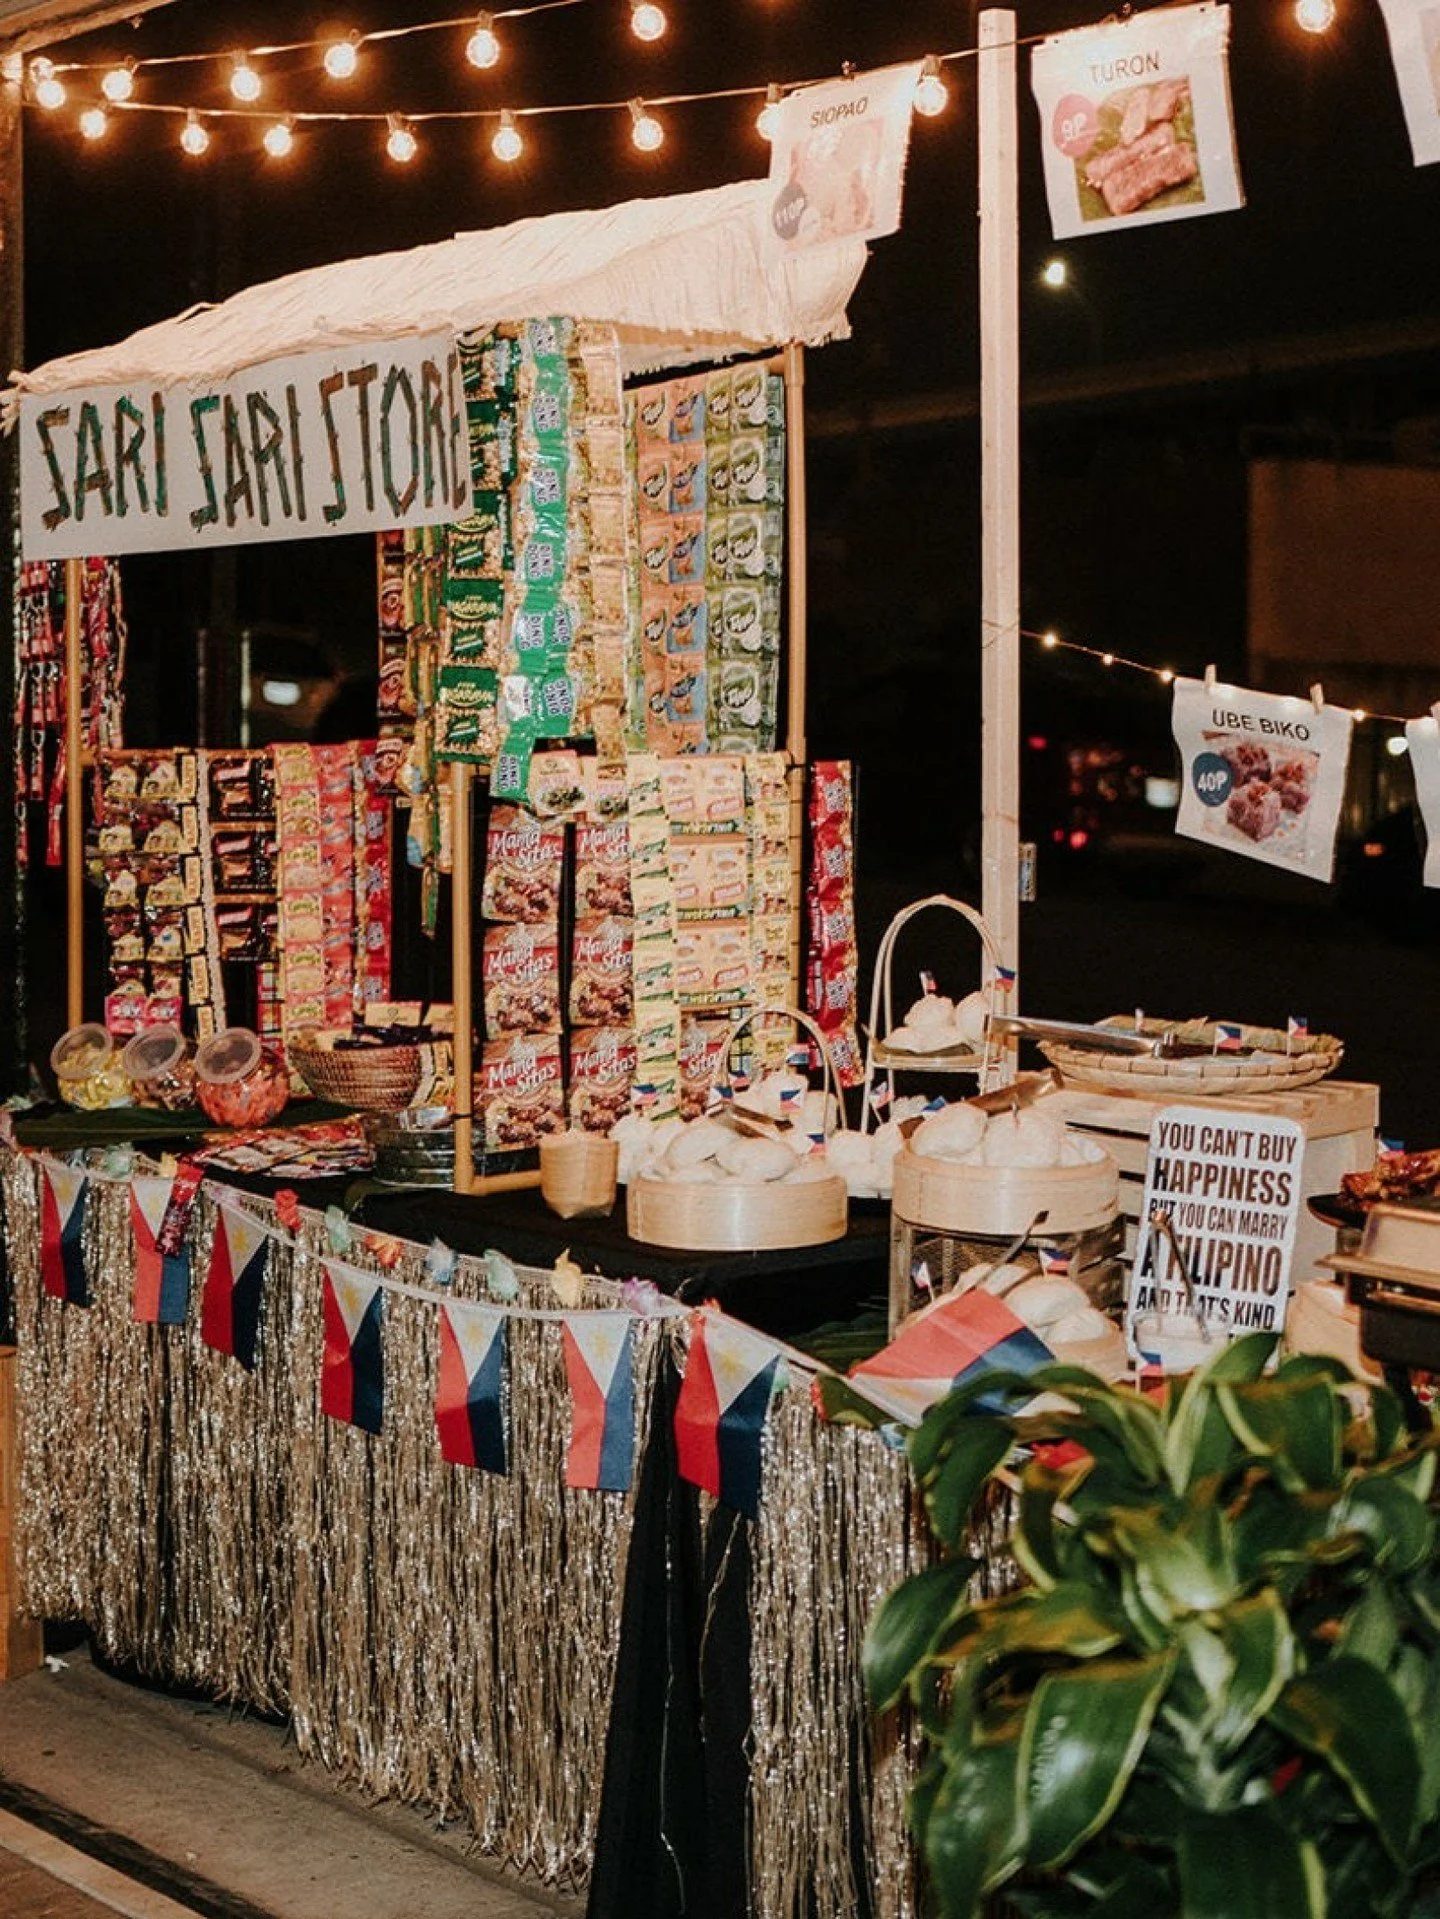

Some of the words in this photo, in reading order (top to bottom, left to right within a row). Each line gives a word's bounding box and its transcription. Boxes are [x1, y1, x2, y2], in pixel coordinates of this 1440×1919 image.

[1090, 51, 1160, 83] TURON
[810, 97, 869, 128] SIOPAO
[36, 391, 169, 530] SARI
[190, 384, 307, 532] SARI
[319, 352, 466, 526] STORE
[1212, 708, 1255, 731] UBE
[1259, 717, 1311, 742] BIKO
[1198, 771, 1228, 792] 40P
[1158, 1121, 1196, 1152] YOU
[1200, 1125, 1255, 1159] CAN'T
[1257, 1133, 1297, 1164] BUY
[1152, 1157, 1293, 1207] HAPPINESS
[1178, 1202, 1205, 1230] YOU
[1206, 1205, 1236, 1234] CAN
[1237, 1209, 1289, 1241] MARRY
[1233, 1300, 1276, 1330] KIND
